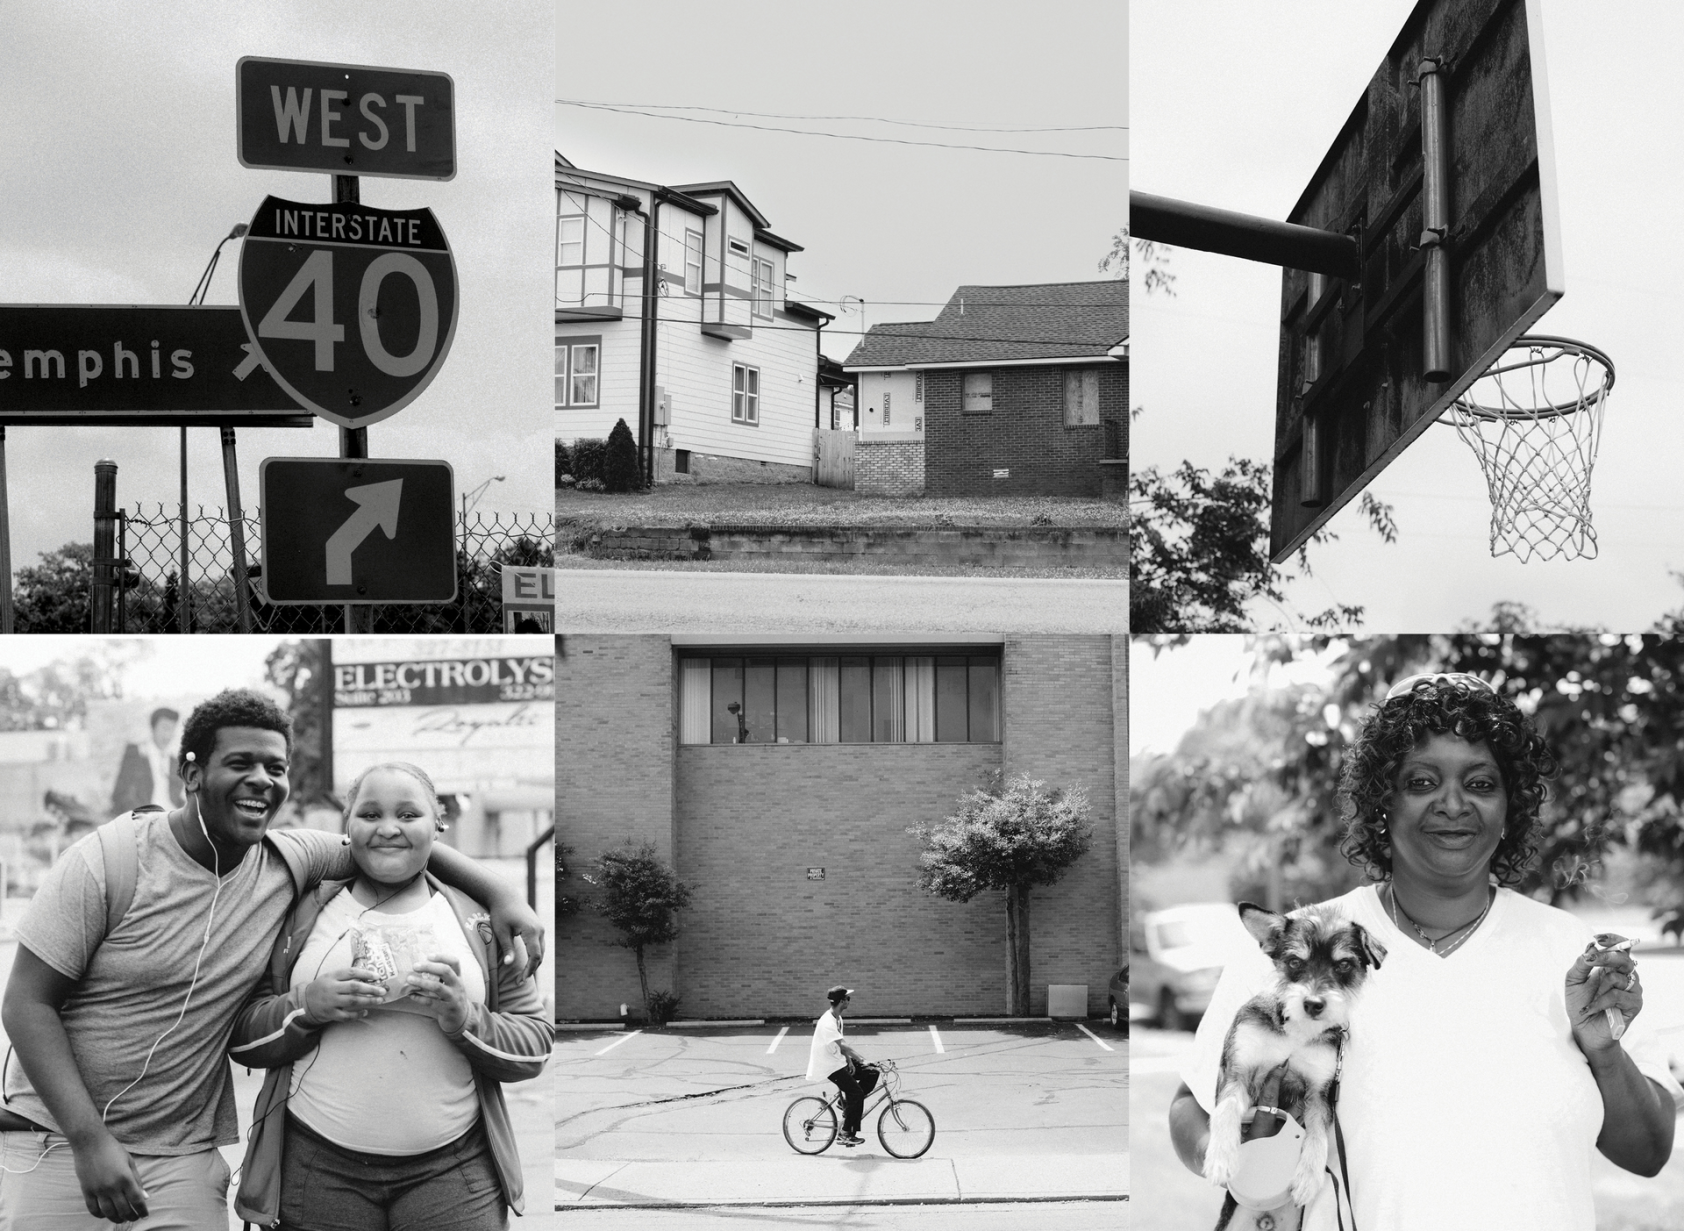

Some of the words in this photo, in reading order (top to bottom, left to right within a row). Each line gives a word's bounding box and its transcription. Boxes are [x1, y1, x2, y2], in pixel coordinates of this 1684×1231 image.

[270, 85, 424, 152] WEST
[276, 209, 421, 244] INTERSTATE
[258, 250, 439, 377] 40
[515, 573, 555, 599] EL
[335, 658, 553, 690] ELECTROLYS
